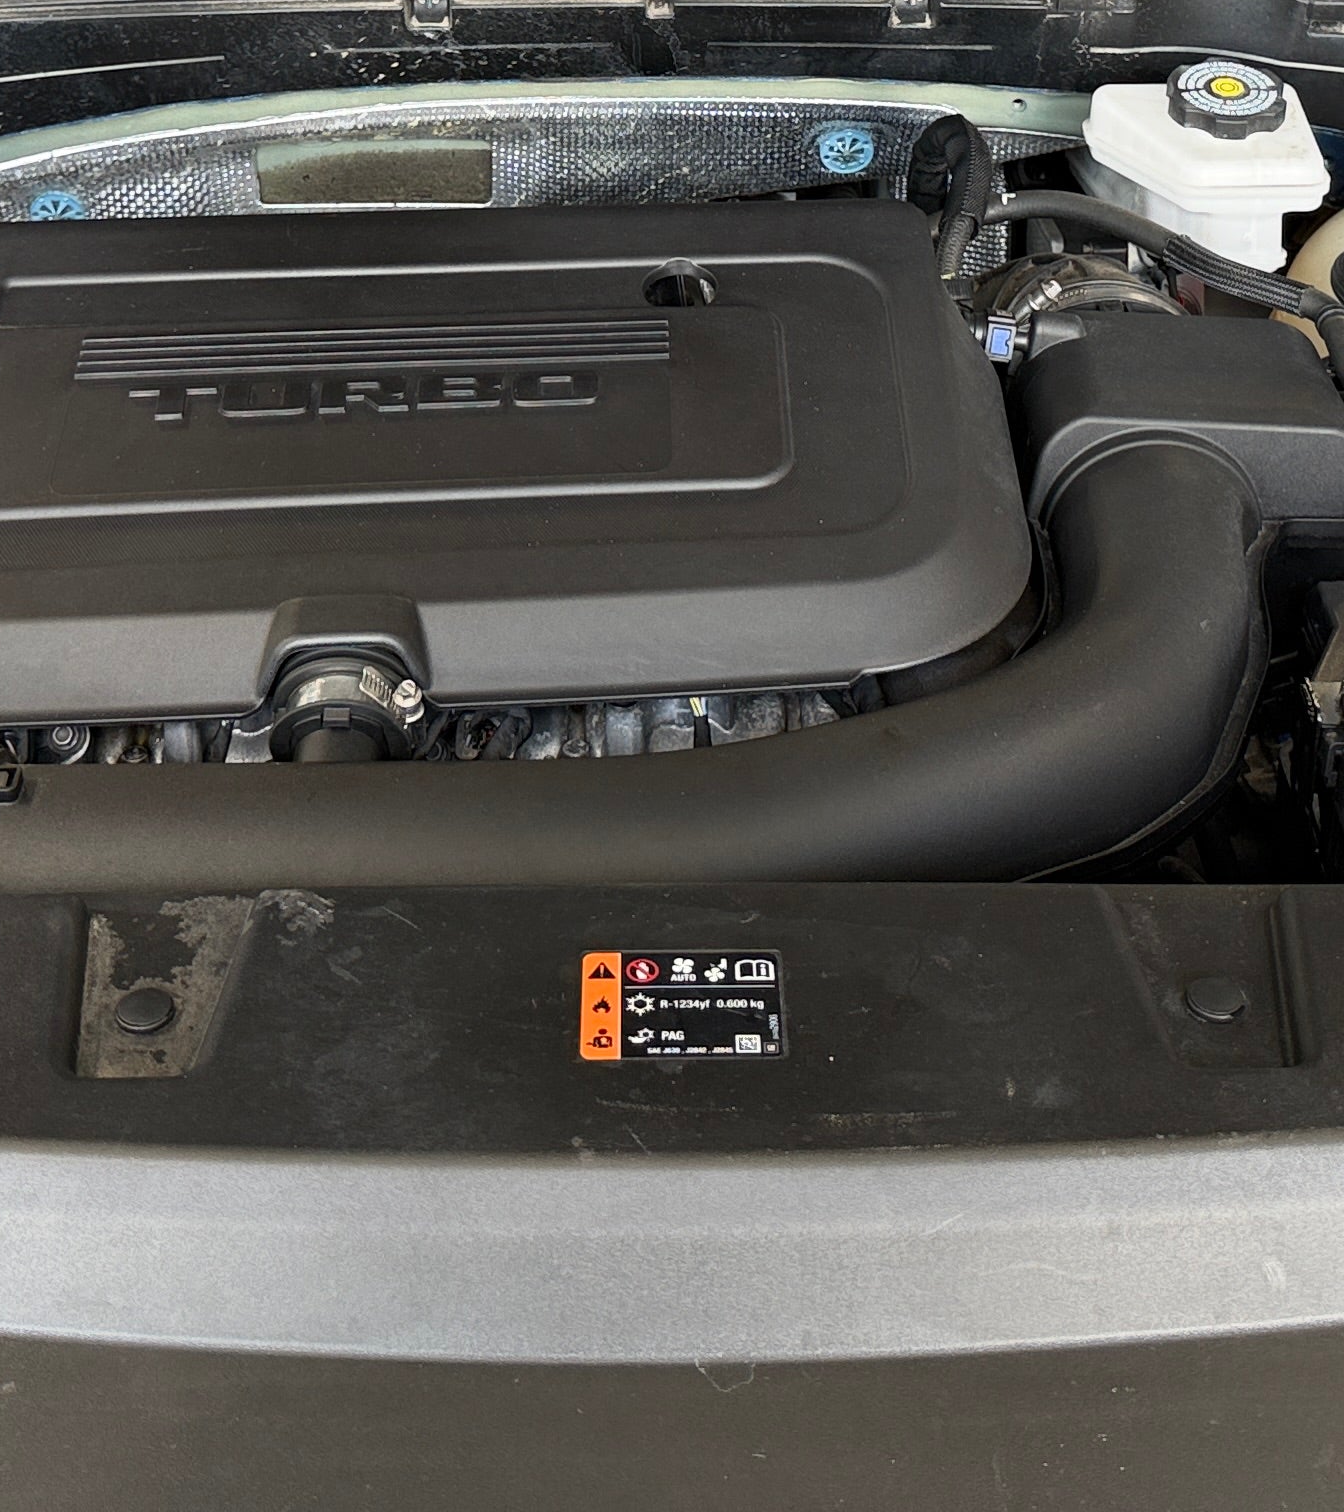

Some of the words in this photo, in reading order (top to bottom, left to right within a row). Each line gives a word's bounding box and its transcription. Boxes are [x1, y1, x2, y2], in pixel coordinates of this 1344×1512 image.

[128, 374, 599, 421] TURBO
[670, 973, 697, 982] AUTO
[659, 999, 711, 1011] R-1234yf
[716, 999, 748, 1009] 0.600
[749, 999, 765, 1010] kg
[661, 1030, 685, 1041] PAG
